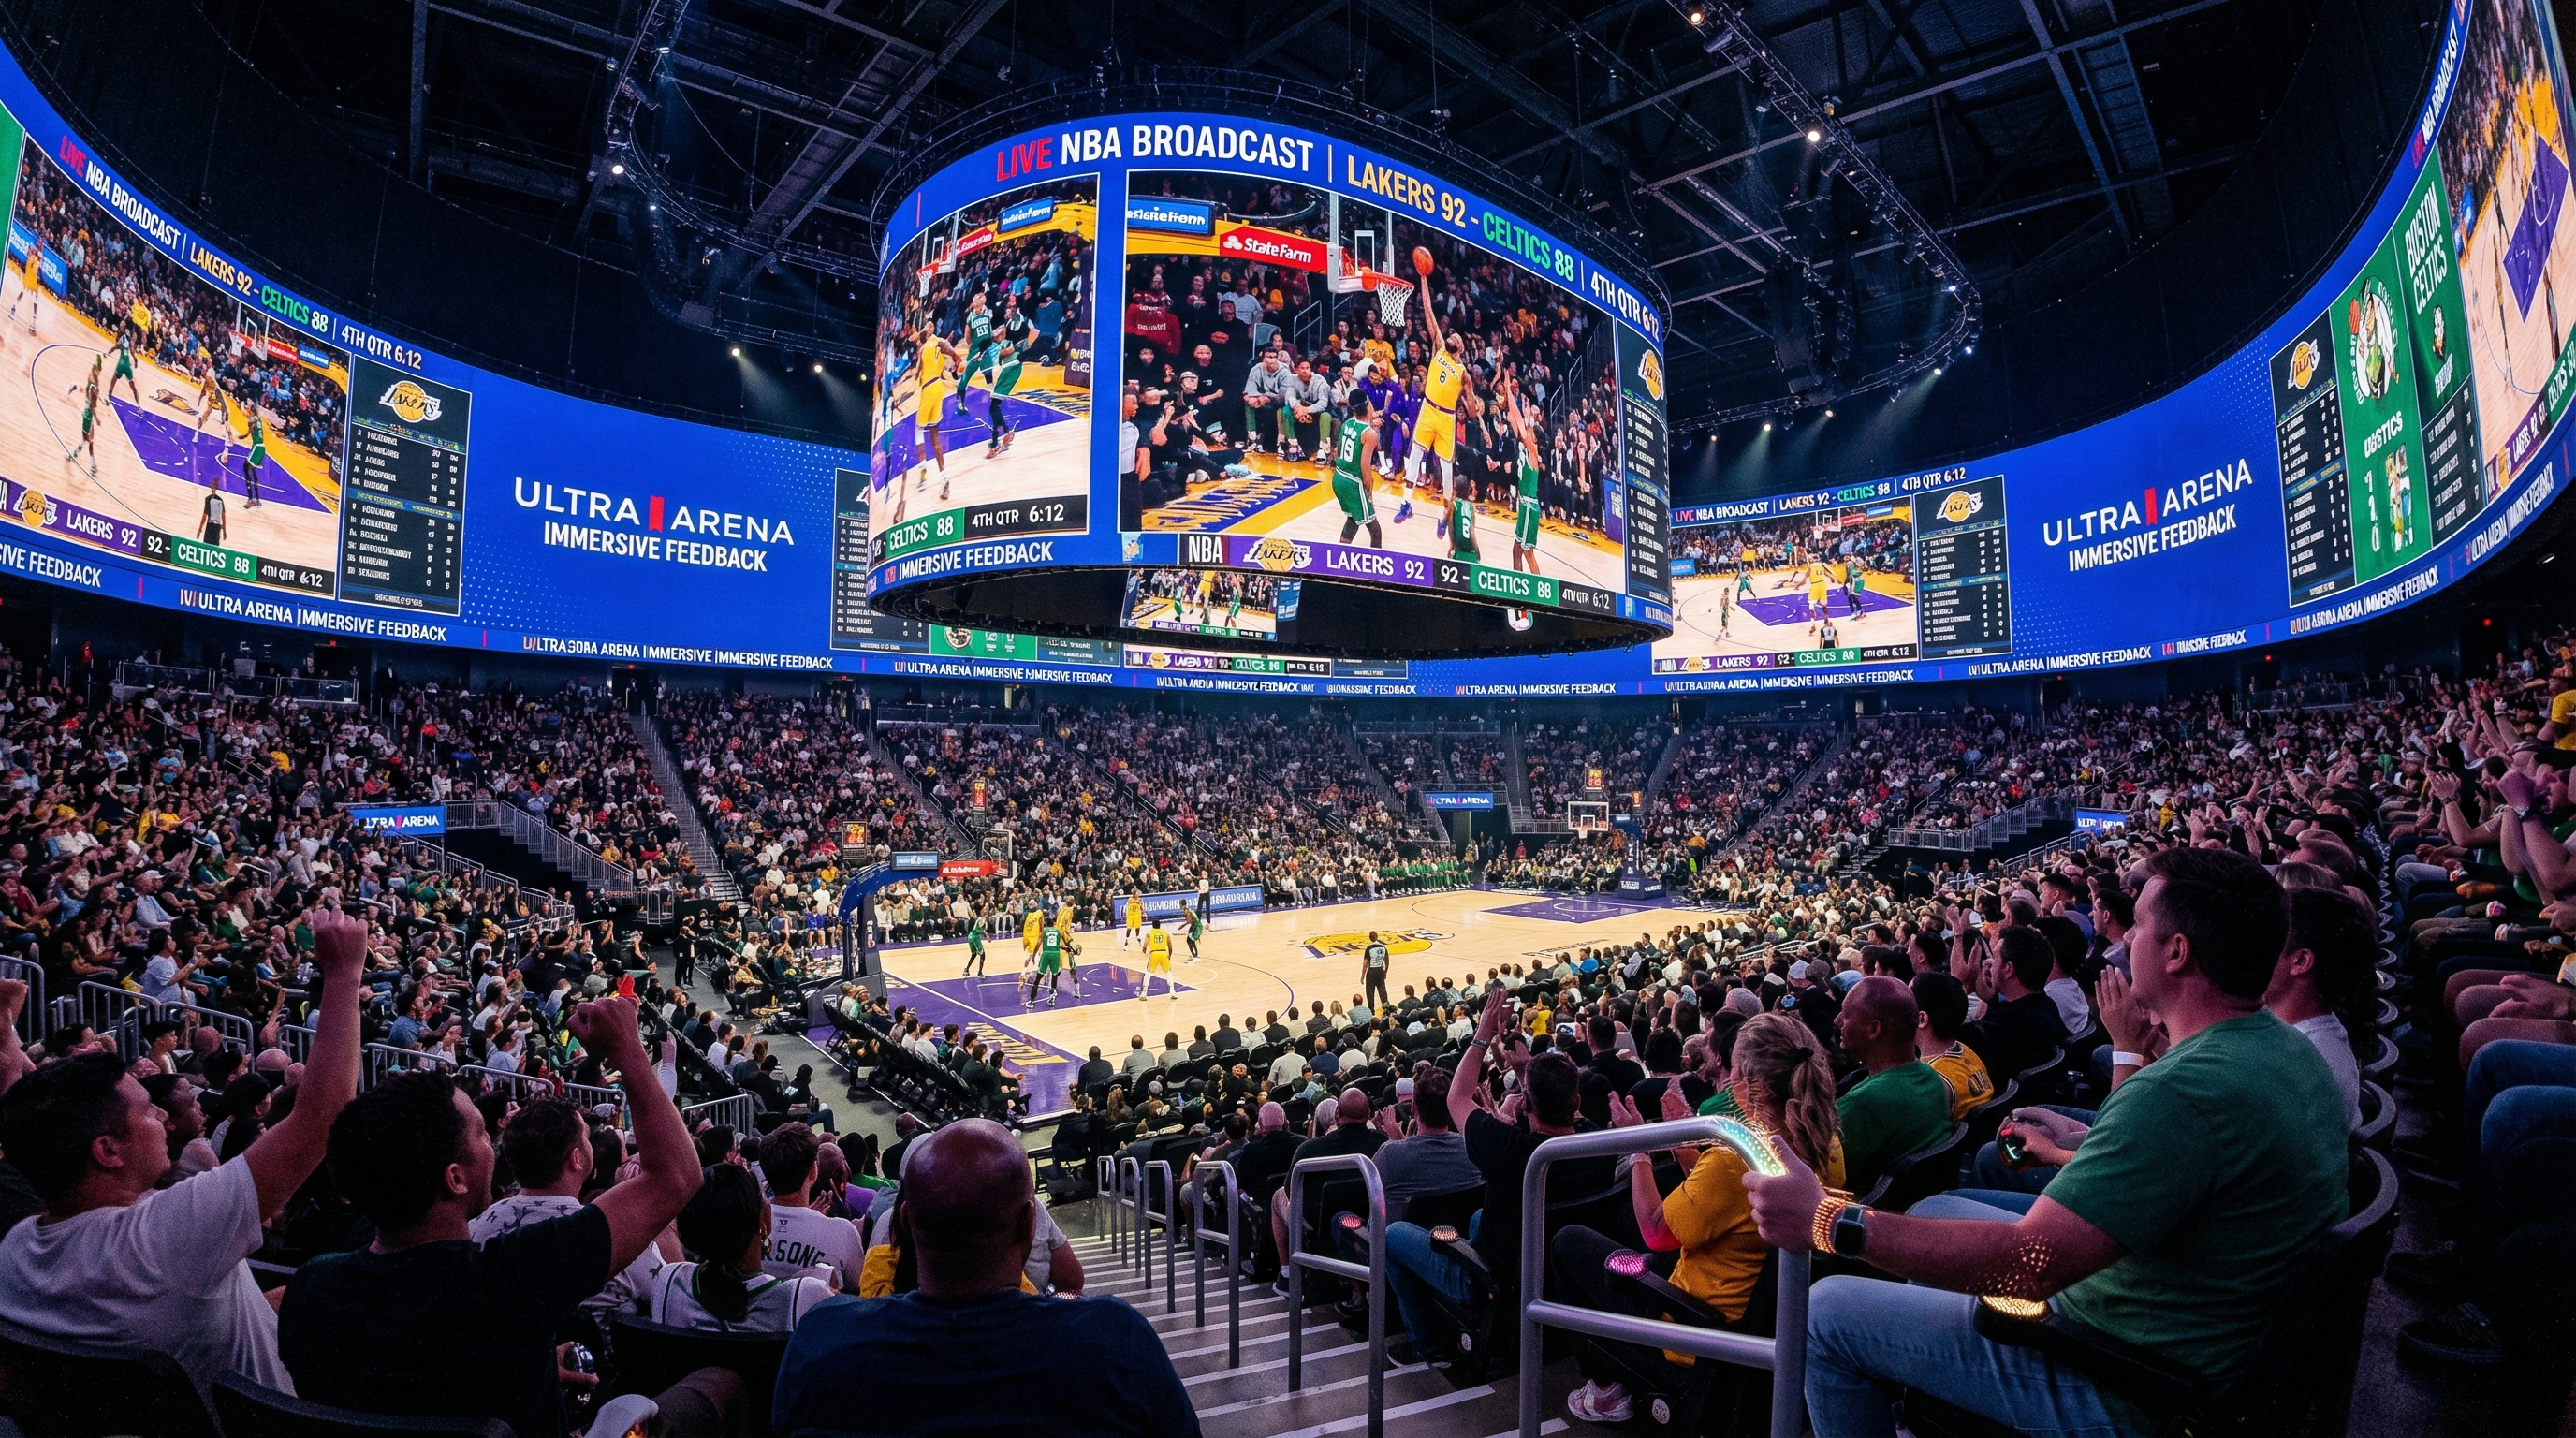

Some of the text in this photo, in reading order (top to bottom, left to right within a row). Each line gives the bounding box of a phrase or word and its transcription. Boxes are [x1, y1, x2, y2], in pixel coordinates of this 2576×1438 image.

[59, 135, 87, 177] LIVE
[85, 160, 110, 199] NBA
[111, 183, 182, 250] BROADCAST
[190, 242, 235, 286] LAKERS
[236, 271, 253, 297] 92
[261, 285, 310, 325] CELTICS
[311, 310, 329, 333] 88
[341, 324, 365, 349] 4TH
[367, 334, 392, 360] QTR
[996, 137, 1053, 182] LIVE
[1061, 127, 1122, 165] NBA
[1132, 125, 1314, 172] BROADCAST
[1348, 154, 1436, 213] LAKERS
[1441, 192, 1466, 228] 92
[1482, 211, 1552, 270] CELTICS
[1555, 248, 1575, 282] 88
[1590, 271, 1616, 307] 4TH
[1617, 287, 1641, 325] QTR
[2405, 181, 2441, 279] BOSTON
[2413, 234, 2447, 315] CELTICS
[514, 477, 795, 545] ULTRA ARENA
[1716, 501, 1769, 519] BROADCAST
[1923, 472, 1942, 489] QTR
[2042, 458, 2253, 547] ULTRA ARENA
[66, 509, 114, 540] LAKERS
[121, 527, 137, 548] 92
[147, 536, 163, 554] 92
[178, 543, 227, 569] CELTICS
[544, 521, 768, 572] IMMERSIVE FEEDBACK
[889, 521, 928, 550] CELTICS
[936, 516, 954, 536] 88
[972, 512, 993, 528] 4TH
[1029, 504, 1064, 523] 6:12
[2069, 504, 2237, 572] IMMERSIVE FEEDBACK
[29, 551, 102, 588] FEEDBACK
[899, 550, 962, 580] IMMERSIVE
[966, 541, 1054, 569] FEEDBACK
[1188, 536, 1223, 563] NBA
[1326, 549, 1394, 576] LAKERS
[1404, 560, 1425, 580] 92
[1441, 565, 1459, 584] 92
[1478, 570, 1530, 596] CELTICS
[198, 592, 243, 616] ULTRA
[244, 598, 293, 624] ARENA
[298, 608, 375, 635] IMMERSIVE
[378, 620, 446, 642] FEEDBACK
[600, 642, 640, 658] ARENA
[643, 644, 712, 663] IMMERSIVE
[714, 649, 778, 667] IMMERSIVE
[780, 654, 833, 669] FEEDBACK
[907, 662, 938, 674] ULTRA
[939, 664, 971, 676] ARENA
[973, 666, 1023, 680] IMMERSIVE
[1866, 669, 1914, 682] FEEDBACK
[1981, 662, 2010, 675] ULTRA
[1487, 684, 1517, 695] ARENA
[402, 815, 440, 828] ARENA
